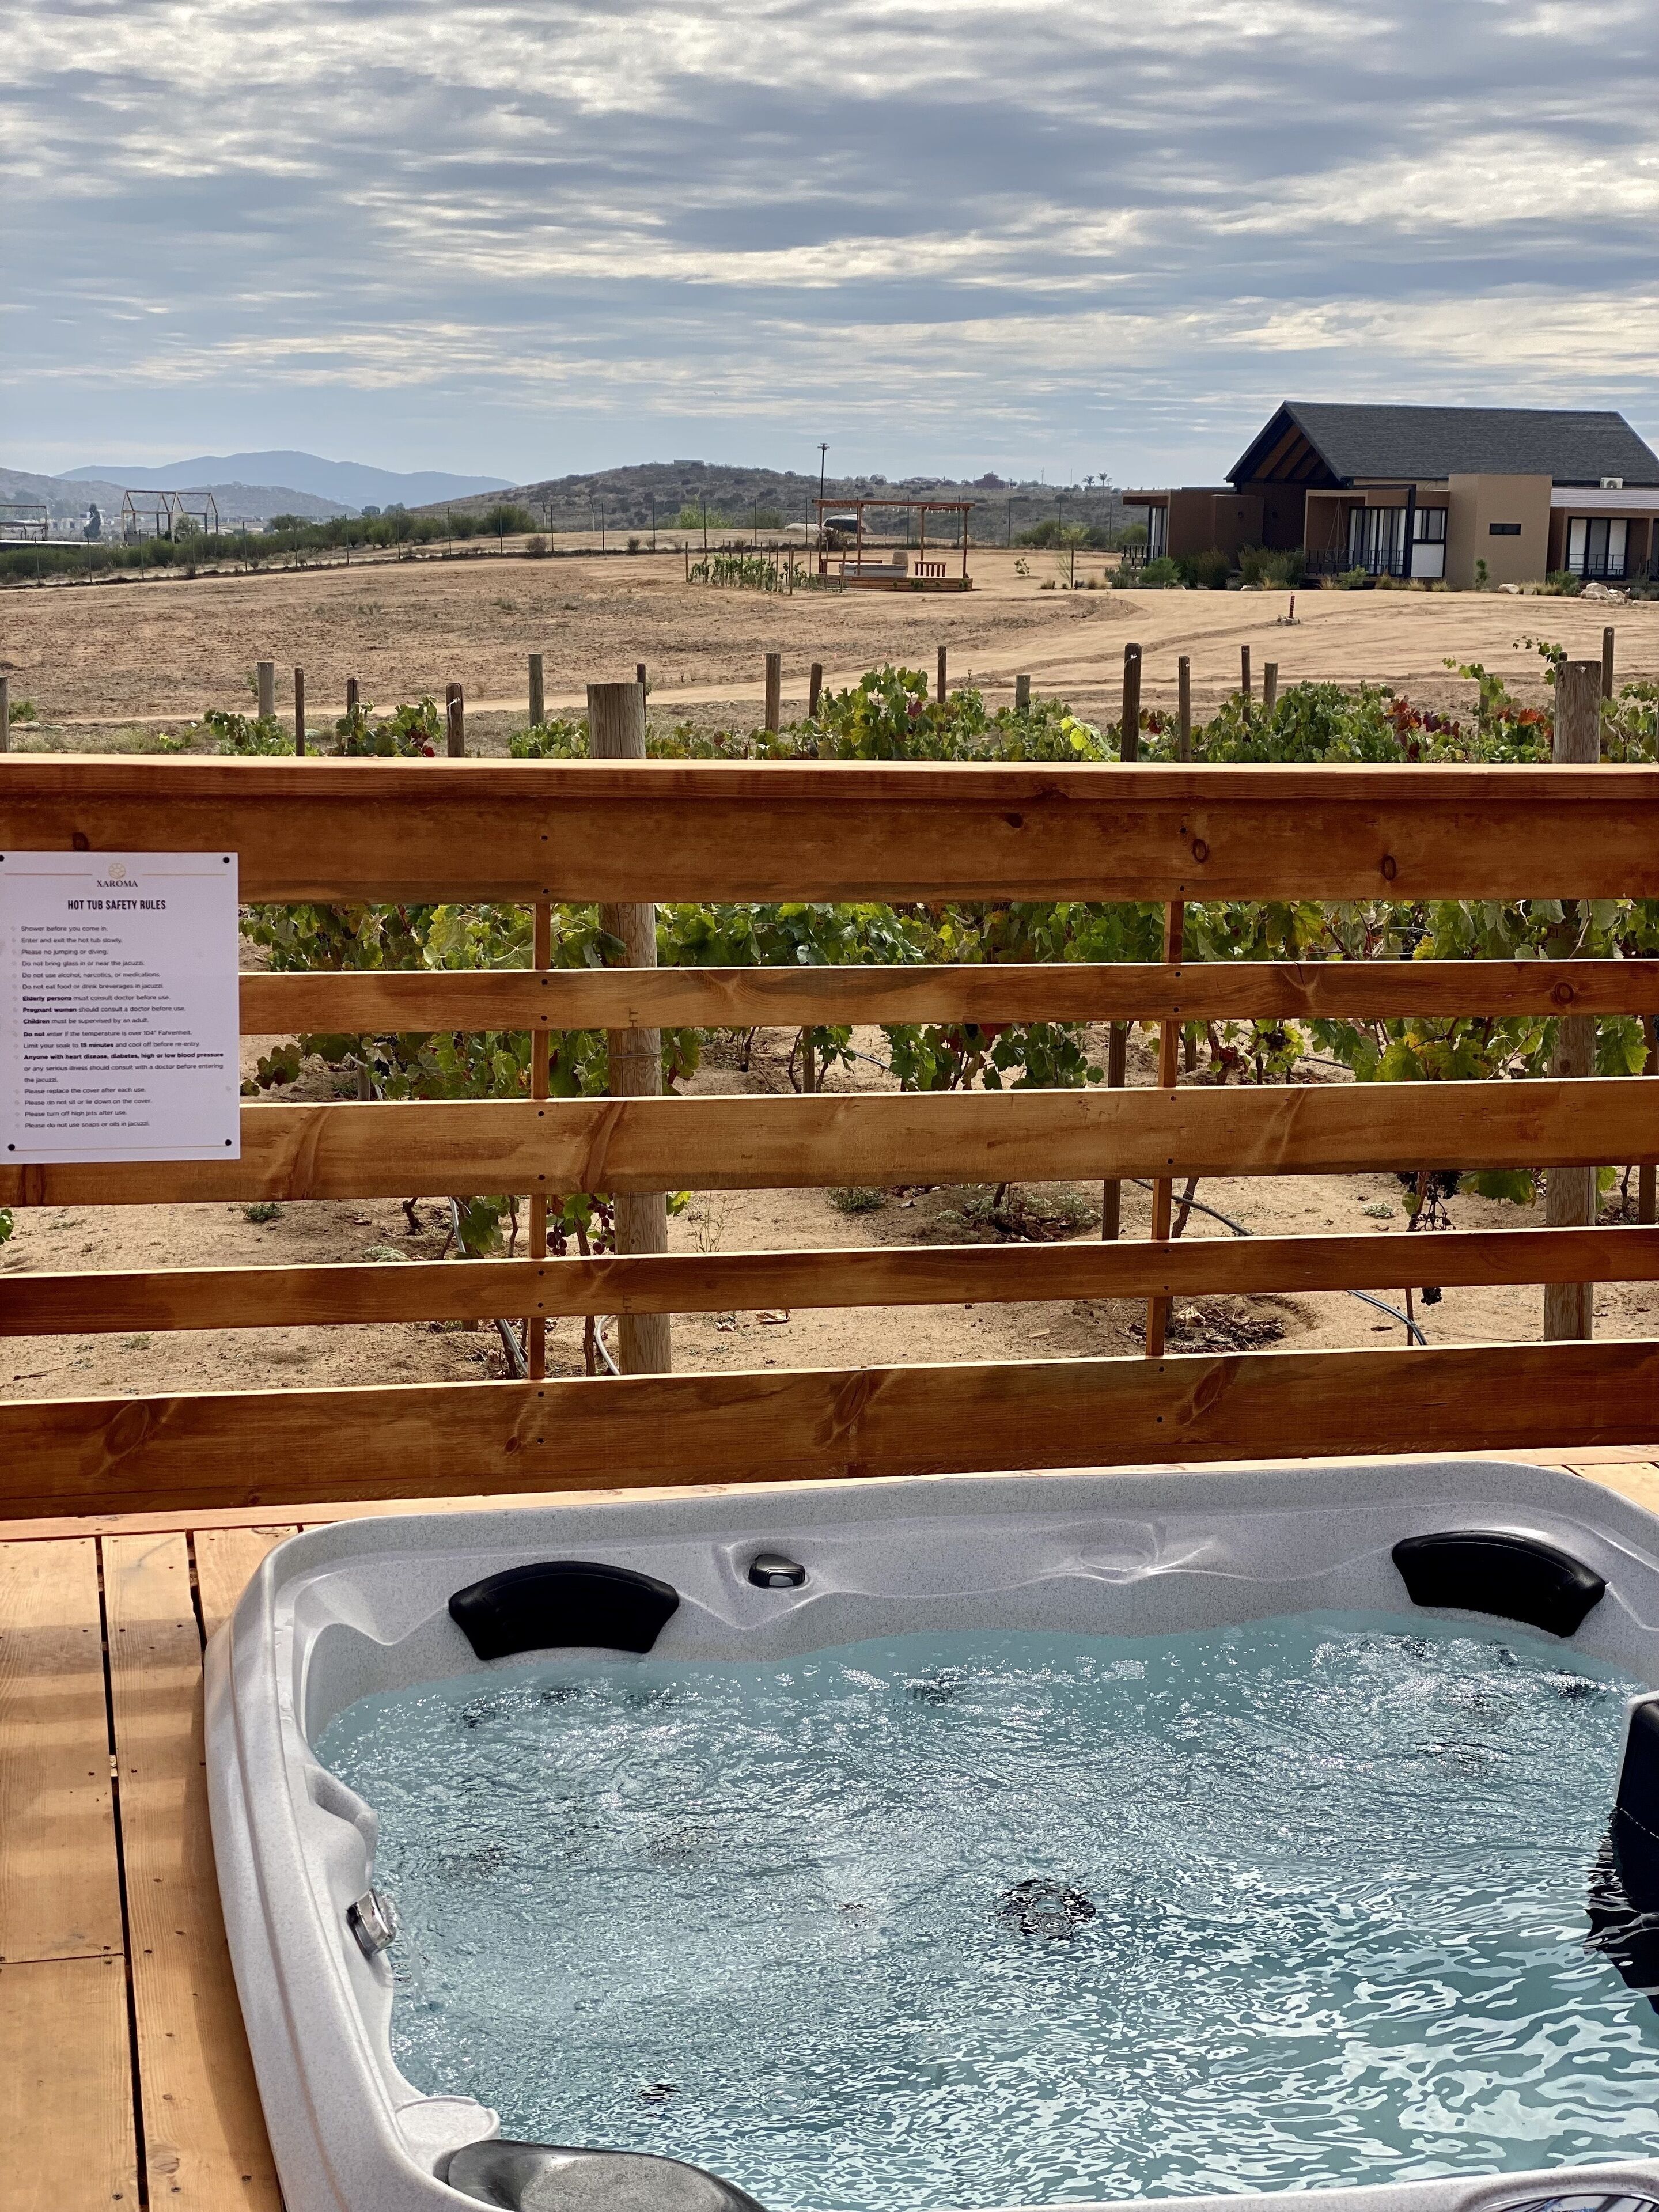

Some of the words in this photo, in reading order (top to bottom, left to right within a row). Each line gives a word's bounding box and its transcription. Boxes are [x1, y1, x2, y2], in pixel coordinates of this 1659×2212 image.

[68, 900, 84, 910] HOT
[86, 900, 103, 910] TUB
[106, 900, 137, 910] SAFETY
[140, 900, 166, 910] RULES
